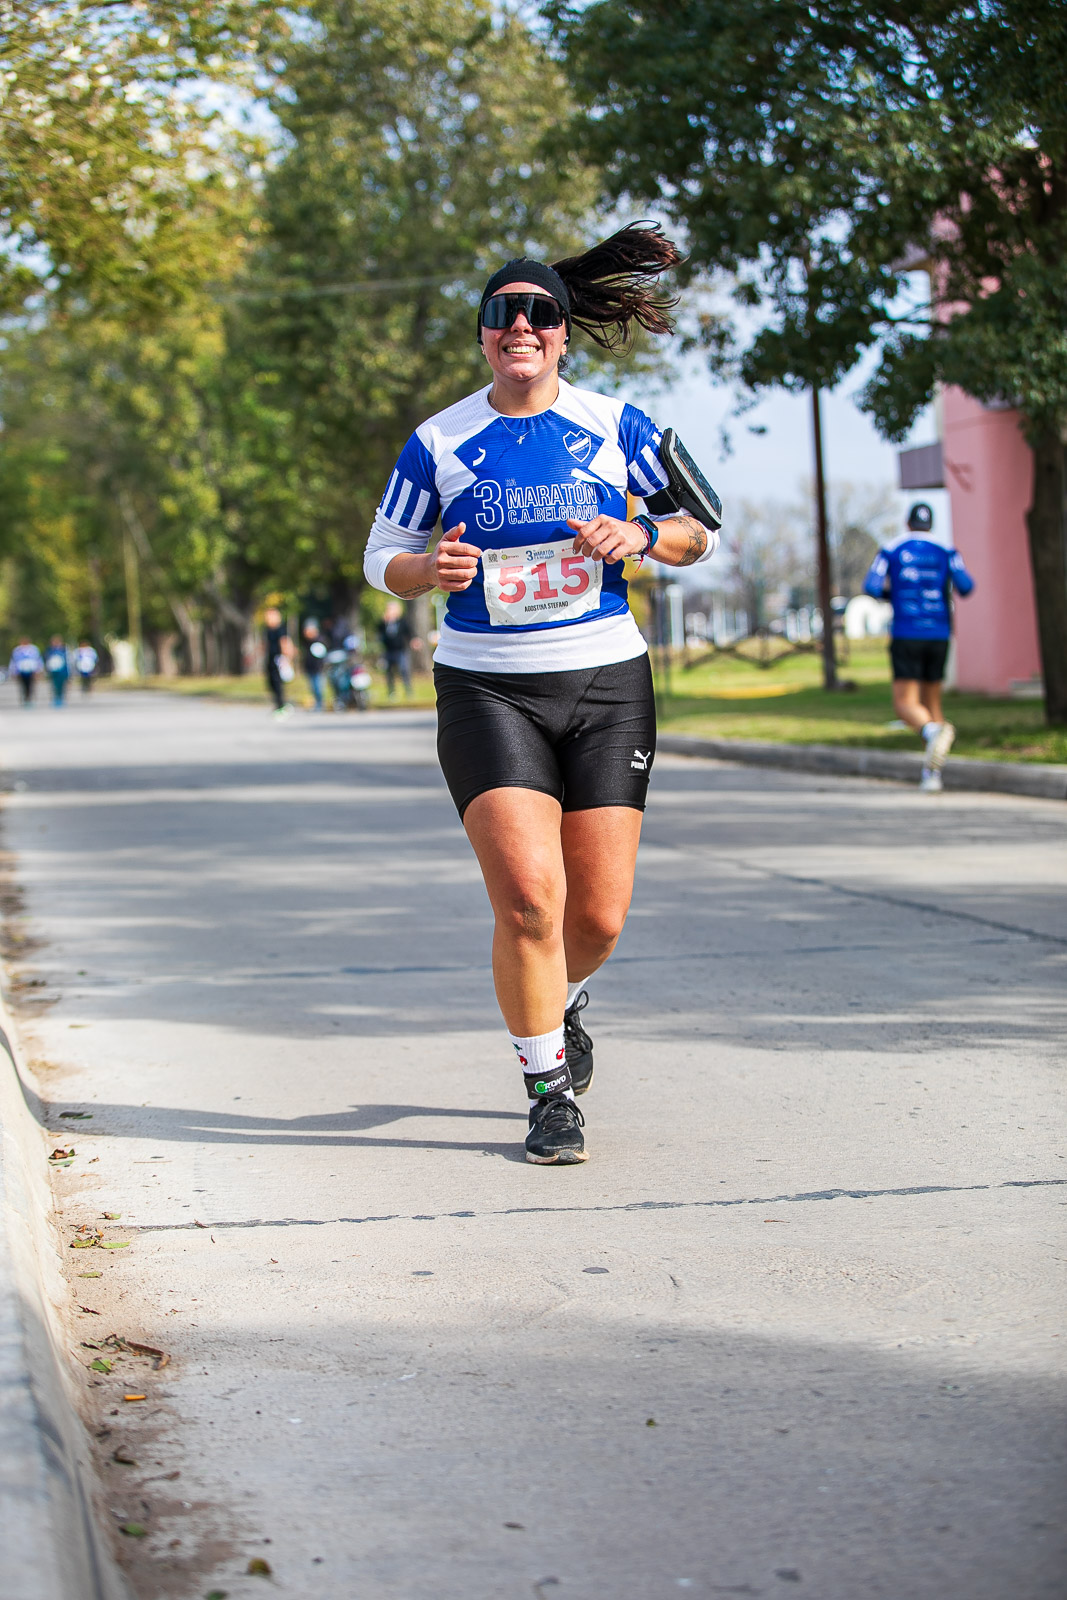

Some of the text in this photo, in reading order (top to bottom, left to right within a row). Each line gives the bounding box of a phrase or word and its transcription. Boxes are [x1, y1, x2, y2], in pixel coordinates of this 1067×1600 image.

[473, 479, 598, 532] 3 MARATÓN
[525, 550, 533, 561] 3
[498, 555, 590, 604] 515
[524, 600, 569, 613] AGOSTINA STEFANO
